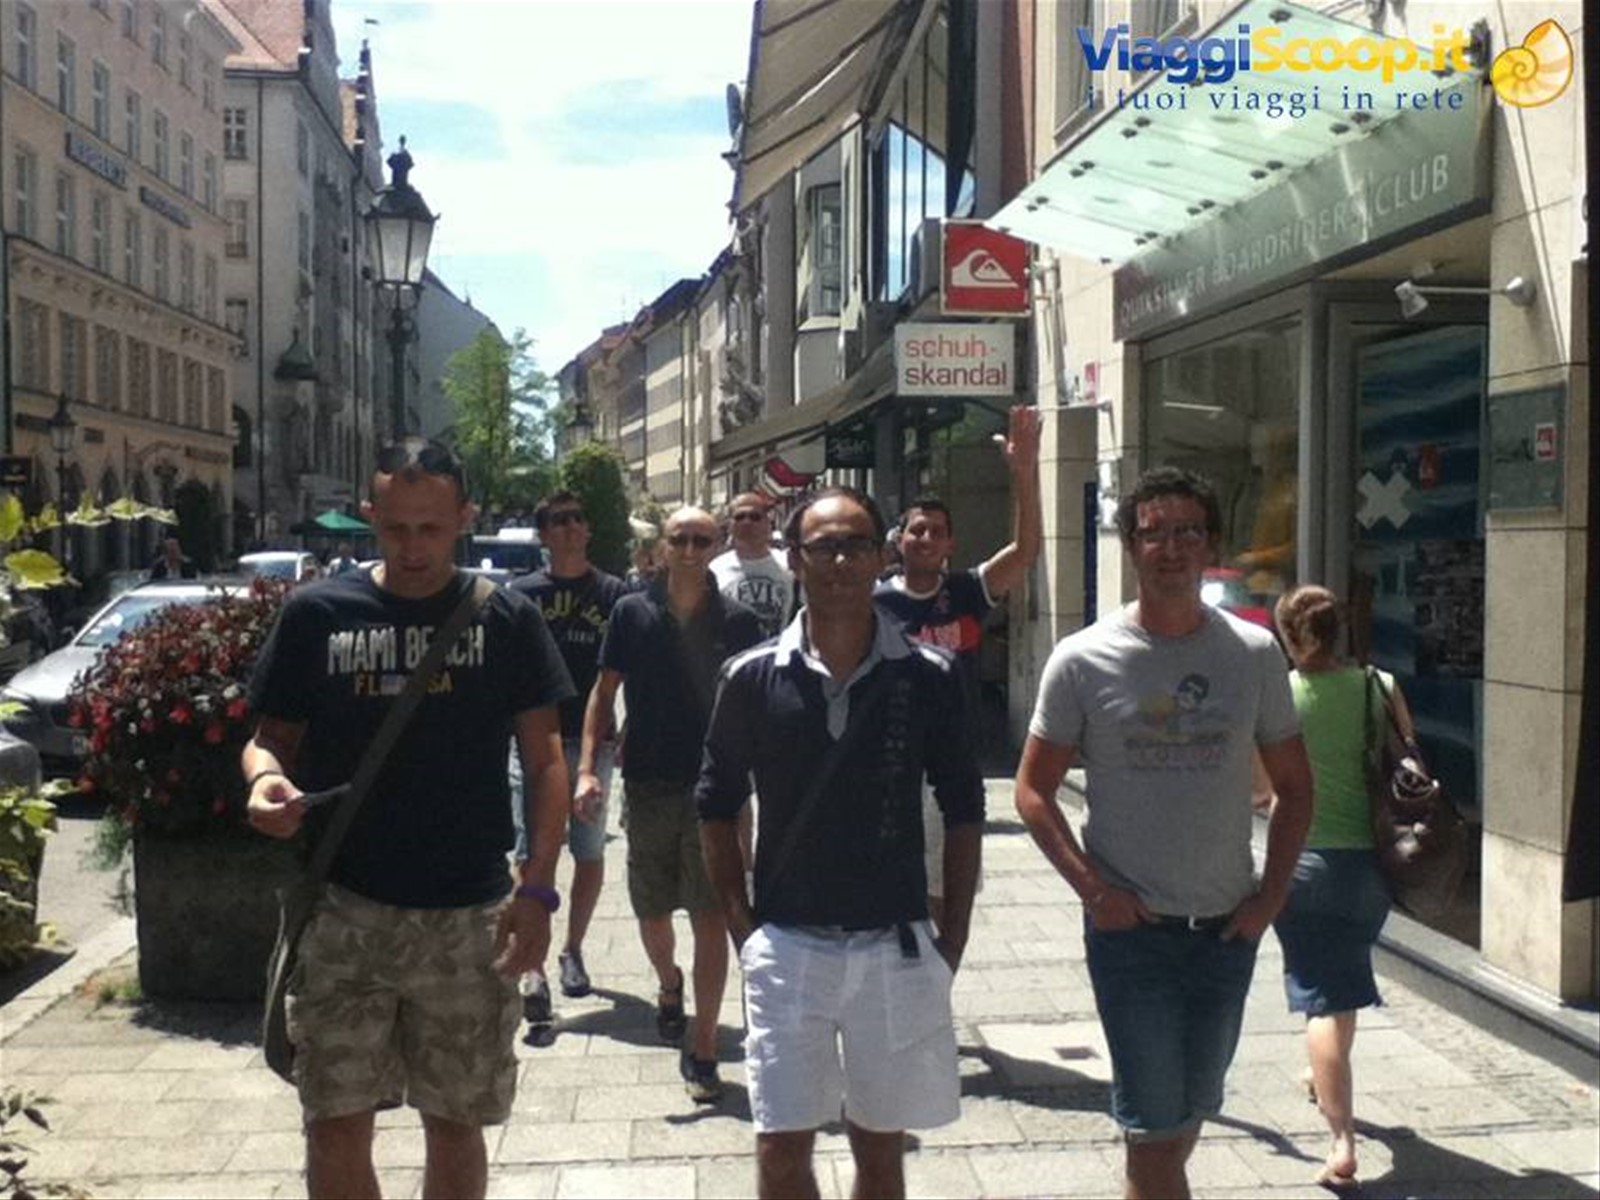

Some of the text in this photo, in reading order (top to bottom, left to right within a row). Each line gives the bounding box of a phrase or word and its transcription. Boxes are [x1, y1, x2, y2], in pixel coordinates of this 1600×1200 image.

[1375, 153, 1449, 216] CLUB
[905, 333, 997, 359] schuh-
[905, 361, 1007, 386] skandal
[327, 624, 485, 676] MIAMI BECH
